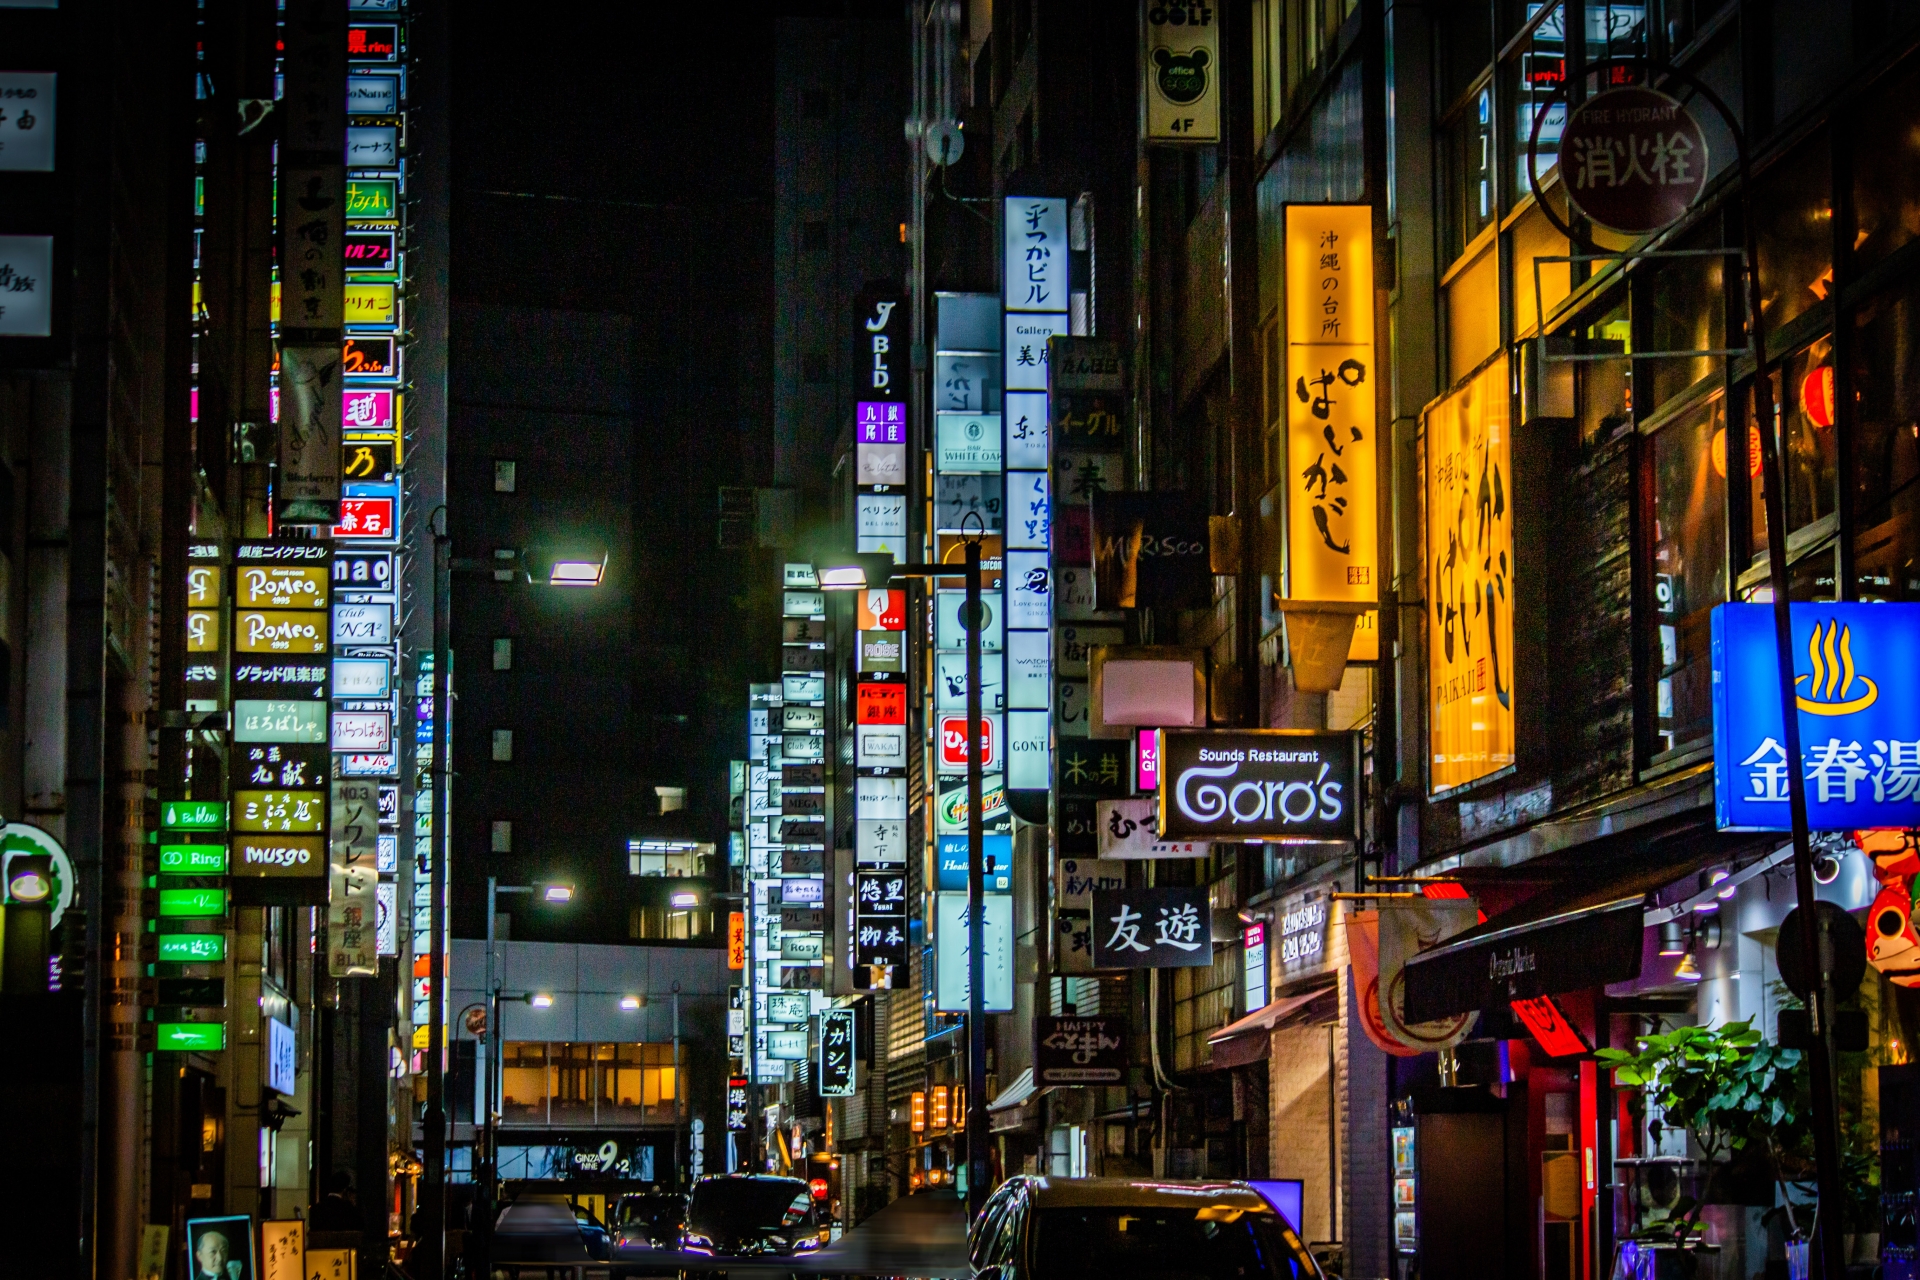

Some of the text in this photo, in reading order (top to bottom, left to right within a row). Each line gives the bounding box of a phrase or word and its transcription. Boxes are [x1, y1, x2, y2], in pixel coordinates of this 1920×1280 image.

[368, 42, 393, 53] ring
[1581, 107, 1678, 125] FIRE HYDRANT
[1170, 118, 1195, 133] 4F
[347, 141, 394, 153] ィーナス
[1572, 130, 1697, 190] 消火栓
[1319, 229, 1342, 338] 沖縄の台所
[1016, 325, 1054, 337] Gallery
[944, 452, 979, 462] WHITE
[1295, 357, 1367, 556] ぱいかじ
[342, 502, 365, 512] ラブ
[342, 511, 382, 532] 赤石
[1198, 748, 1319, 764] Sounds Restaurant
[1738, 736, 1920, 804] 金春湯
[190, 852, 222, 868] Ring
[790, 943, 819, 956] Rosy
[574, 1152, 601, 1164] GINZA
[598, 1139, 618, 1173] 9
[581, 1162, 599, 1171] NINE
[620, 1158, 630, 1173] 2
